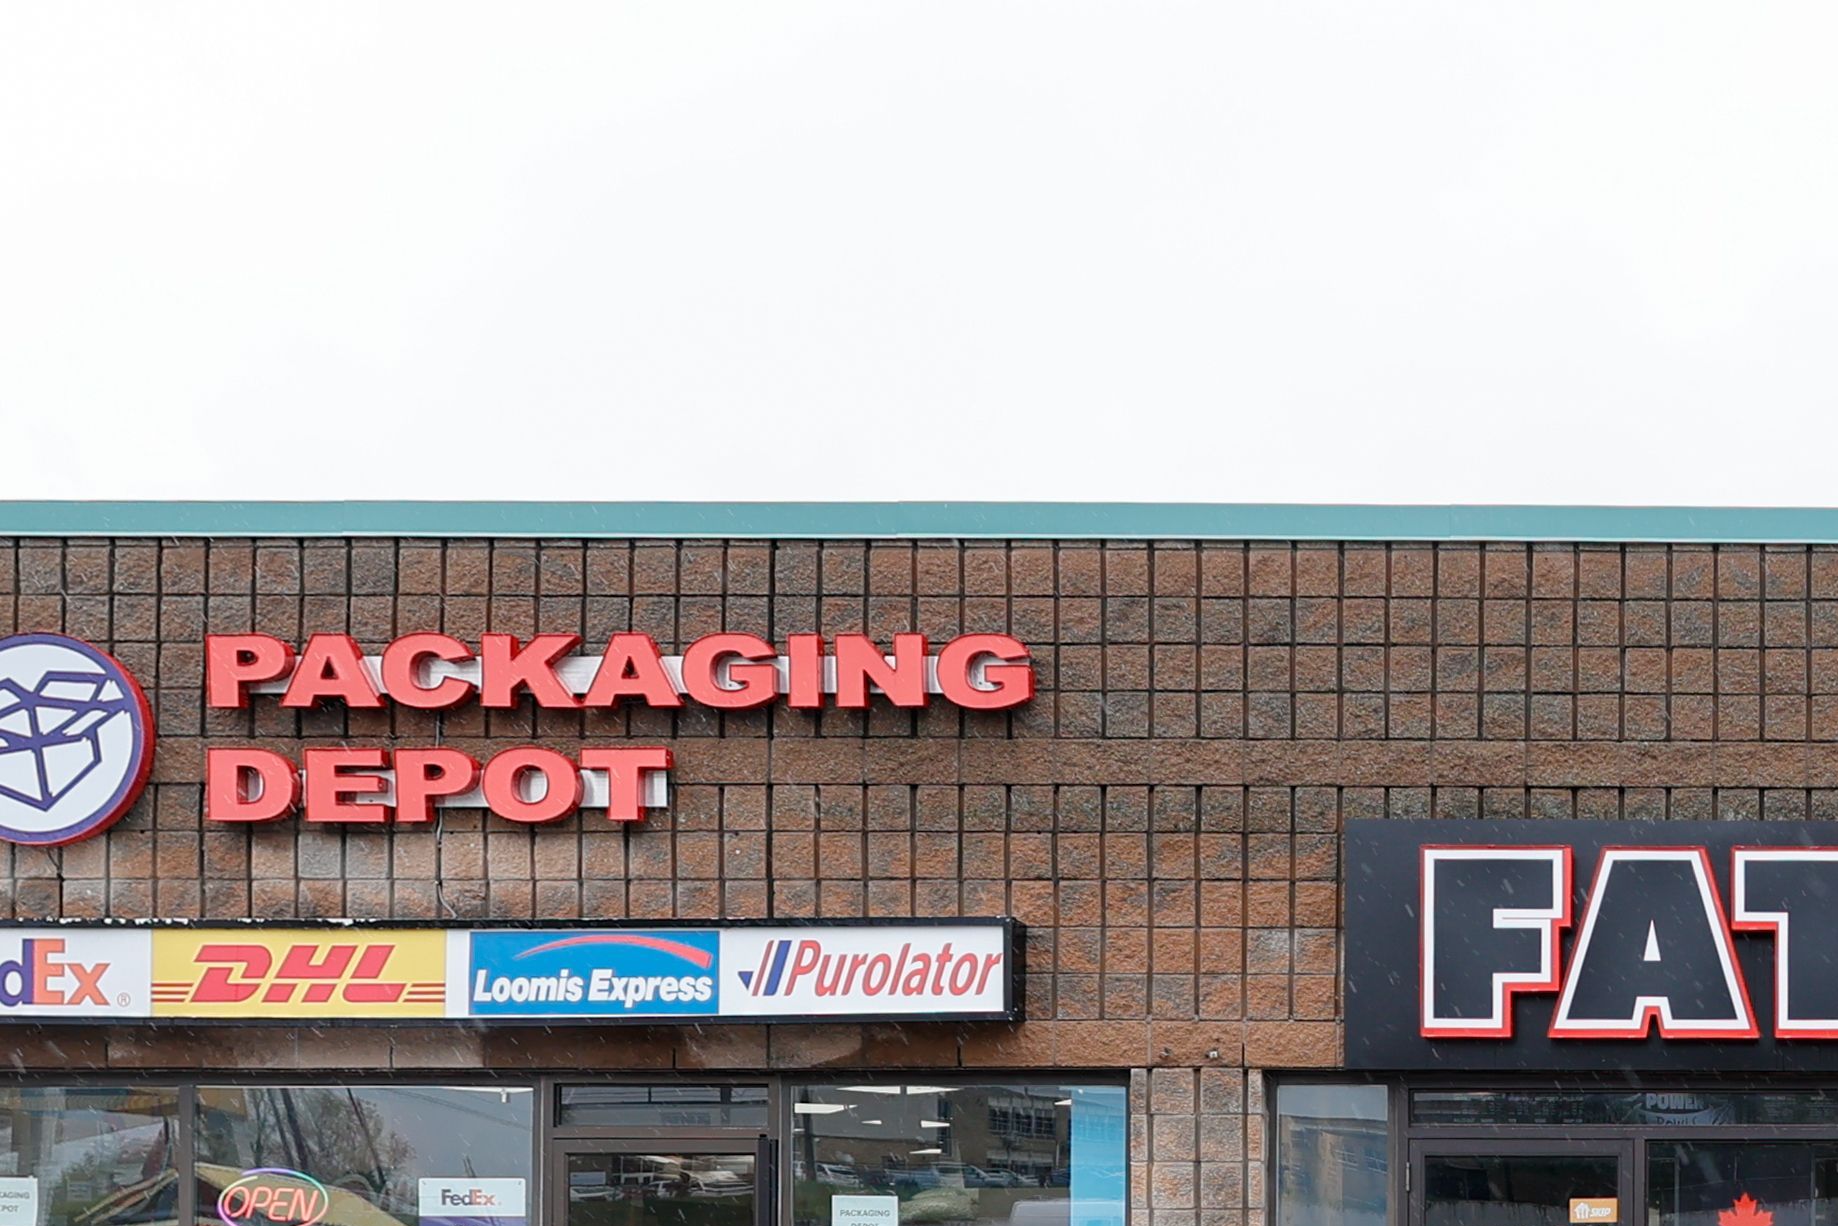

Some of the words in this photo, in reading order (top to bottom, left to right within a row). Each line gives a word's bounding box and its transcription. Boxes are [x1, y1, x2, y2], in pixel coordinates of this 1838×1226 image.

[205, 632, 1036, 711] PACKAGING
[206, 745, 674, 824] DEPOT
[188, 944, 408, 1004] DHL
[473, 967, 583, 1004] Loomis
[588, 968, 713, 1008] Express
[784, 938, 1004, 998] Purolator
[222, 1184, 320, 1224] OPEN
[440, 1188, 496, 1207] FedEx
[839, 1209, 891, 1218] PACKAGING
